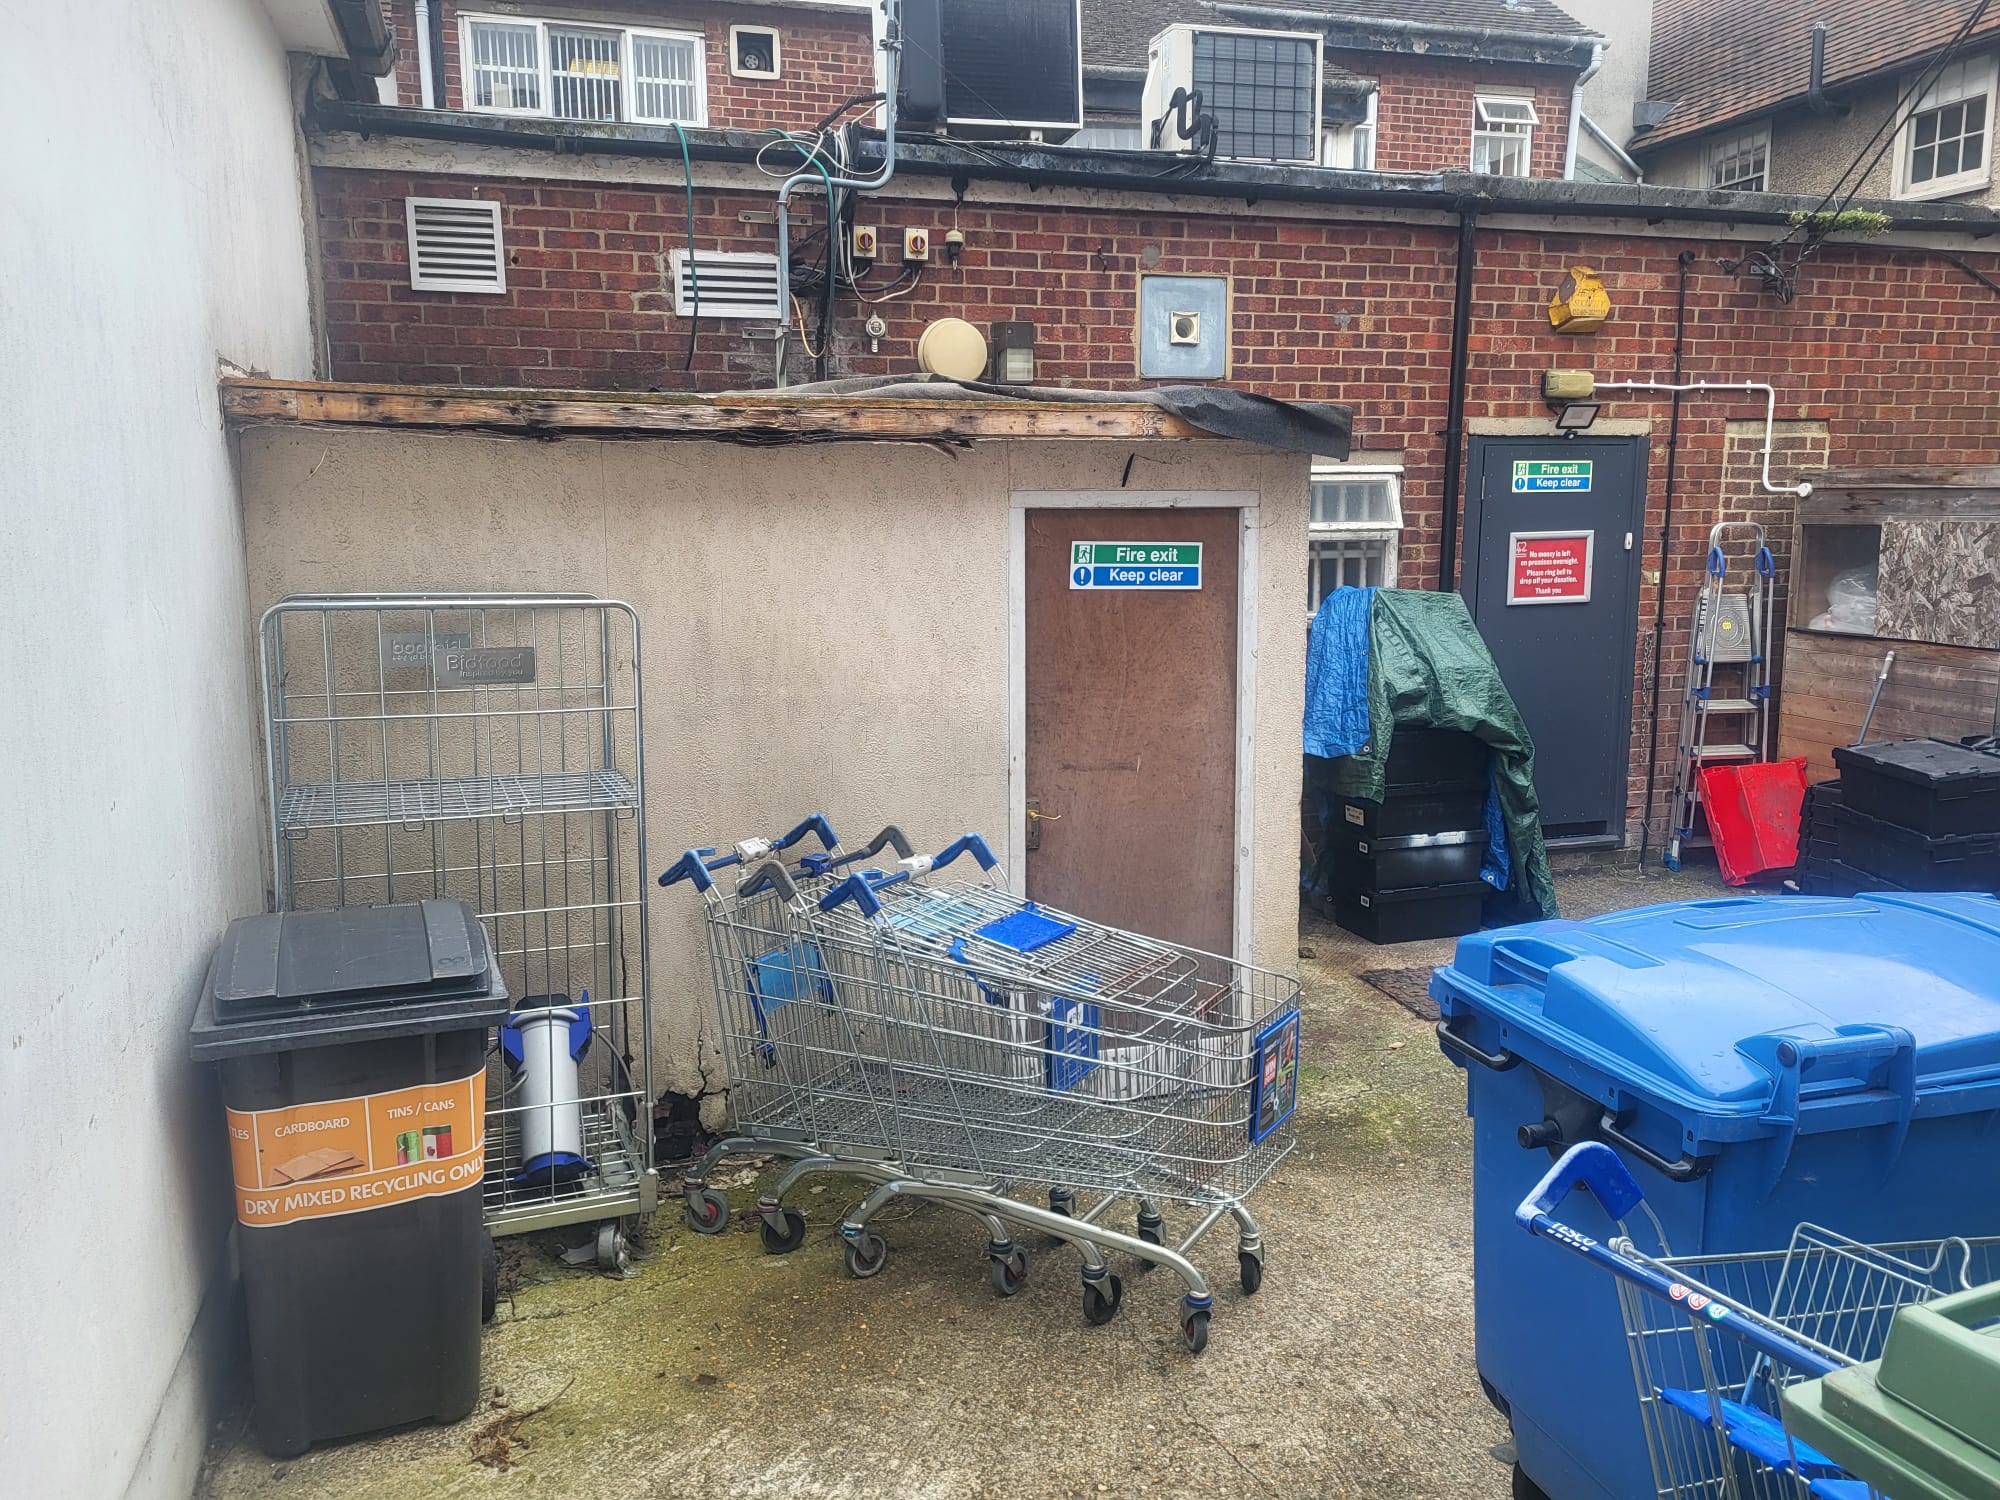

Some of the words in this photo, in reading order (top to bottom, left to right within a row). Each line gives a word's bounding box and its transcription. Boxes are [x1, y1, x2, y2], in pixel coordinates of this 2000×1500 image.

[1541, 464, 1559, 474] Fire
[1562, 464, 1578, 474] exit
[1536, 478, 1558, 488] Keep
[1560, 478, 1581, 487] clear
[1116, 547, 1146, 562] Fire
[1150, 547, 1178, 562] exit
[1109, 568, 1144, 584] Keep
[1149, 568, 1184, 581] clear
[1526, 569, 1544, 577] Please
[1552, 587, 1562, 595] you
[446, 653, 523, 671] Bidfood
[387, 1106, 414, 1120] TINS
[423, 1098, 455, 1113] CANS
[274, 1116, 350, 1138] CARDBOARD
[244, 1198, 280, 1216] DRY
[284, 1188, 346, 1212] MIXED
[350, 1169, 446, 1201] RECYCLING
[449, 1152, 484, 1181] ONLY
[1552, 1222, 1598, 1247] TESCO
